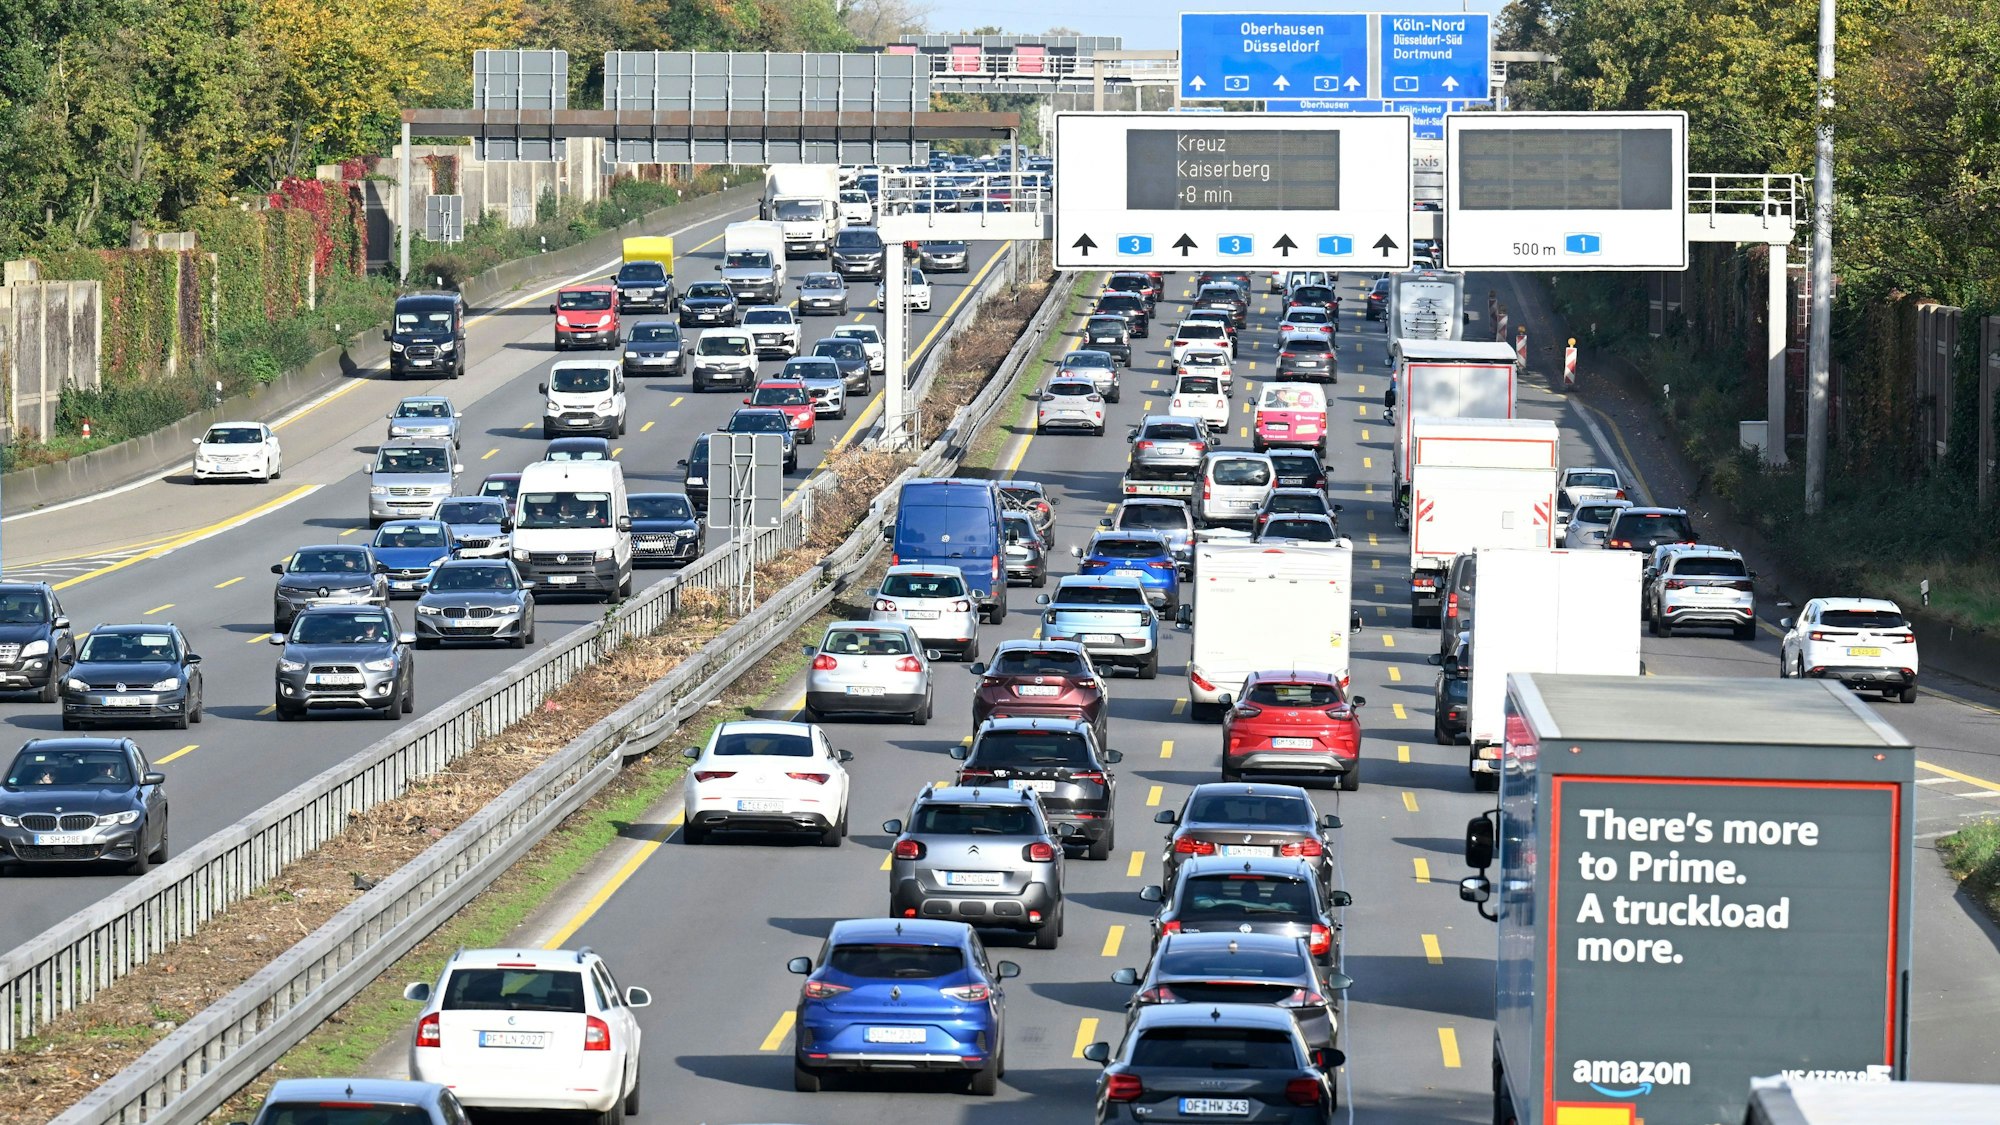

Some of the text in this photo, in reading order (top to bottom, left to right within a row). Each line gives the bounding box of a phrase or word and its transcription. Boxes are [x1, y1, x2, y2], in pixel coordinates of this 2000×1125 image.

[1240, 22, 1324, 36] Oberhausen
[1393, 18, 1465, 32] Köln-Nord
[1243, 40, 1320, 52] Düsseldorf
[1393, 34, 1462, 45] Düsseldorf-Süd
[1393, 48, 1452, 60] Dortmund
[1233, 78, 1240, 88] 3
[1322, 78, 1330, 88] 3
[1404, 78, 1408, 88] 1
[1300, 100, 1349, 108] Oberhausen
[1177, 134, 1226, 152] Kreuz
[1177, 160, 1270, 181] Kaiserberg
[1177, 186, 1232, 203] +8 min
[1131, 238, 1140, 252] 3
[1232, 238, 1240, 252] 3
[1332, 238, 1338, 252] 1
[1512, 242, 1556, 256] 500 m
[1580, 238, 1586, 251] 1
[1723, 819, 1819, 846] more
[1578, 850, 1747, 884] to Prime.
[1576, 892, 1790, 929] A truckload
[1577, 937, 1684, 964] more.
[486, 1034, 497, 1044] PF
[520, 1035, 543, 1045] 2927
[1572, 1059, 1691, 1086] amazon
[1186, 1100, 1248, 1113] OF HW 343
